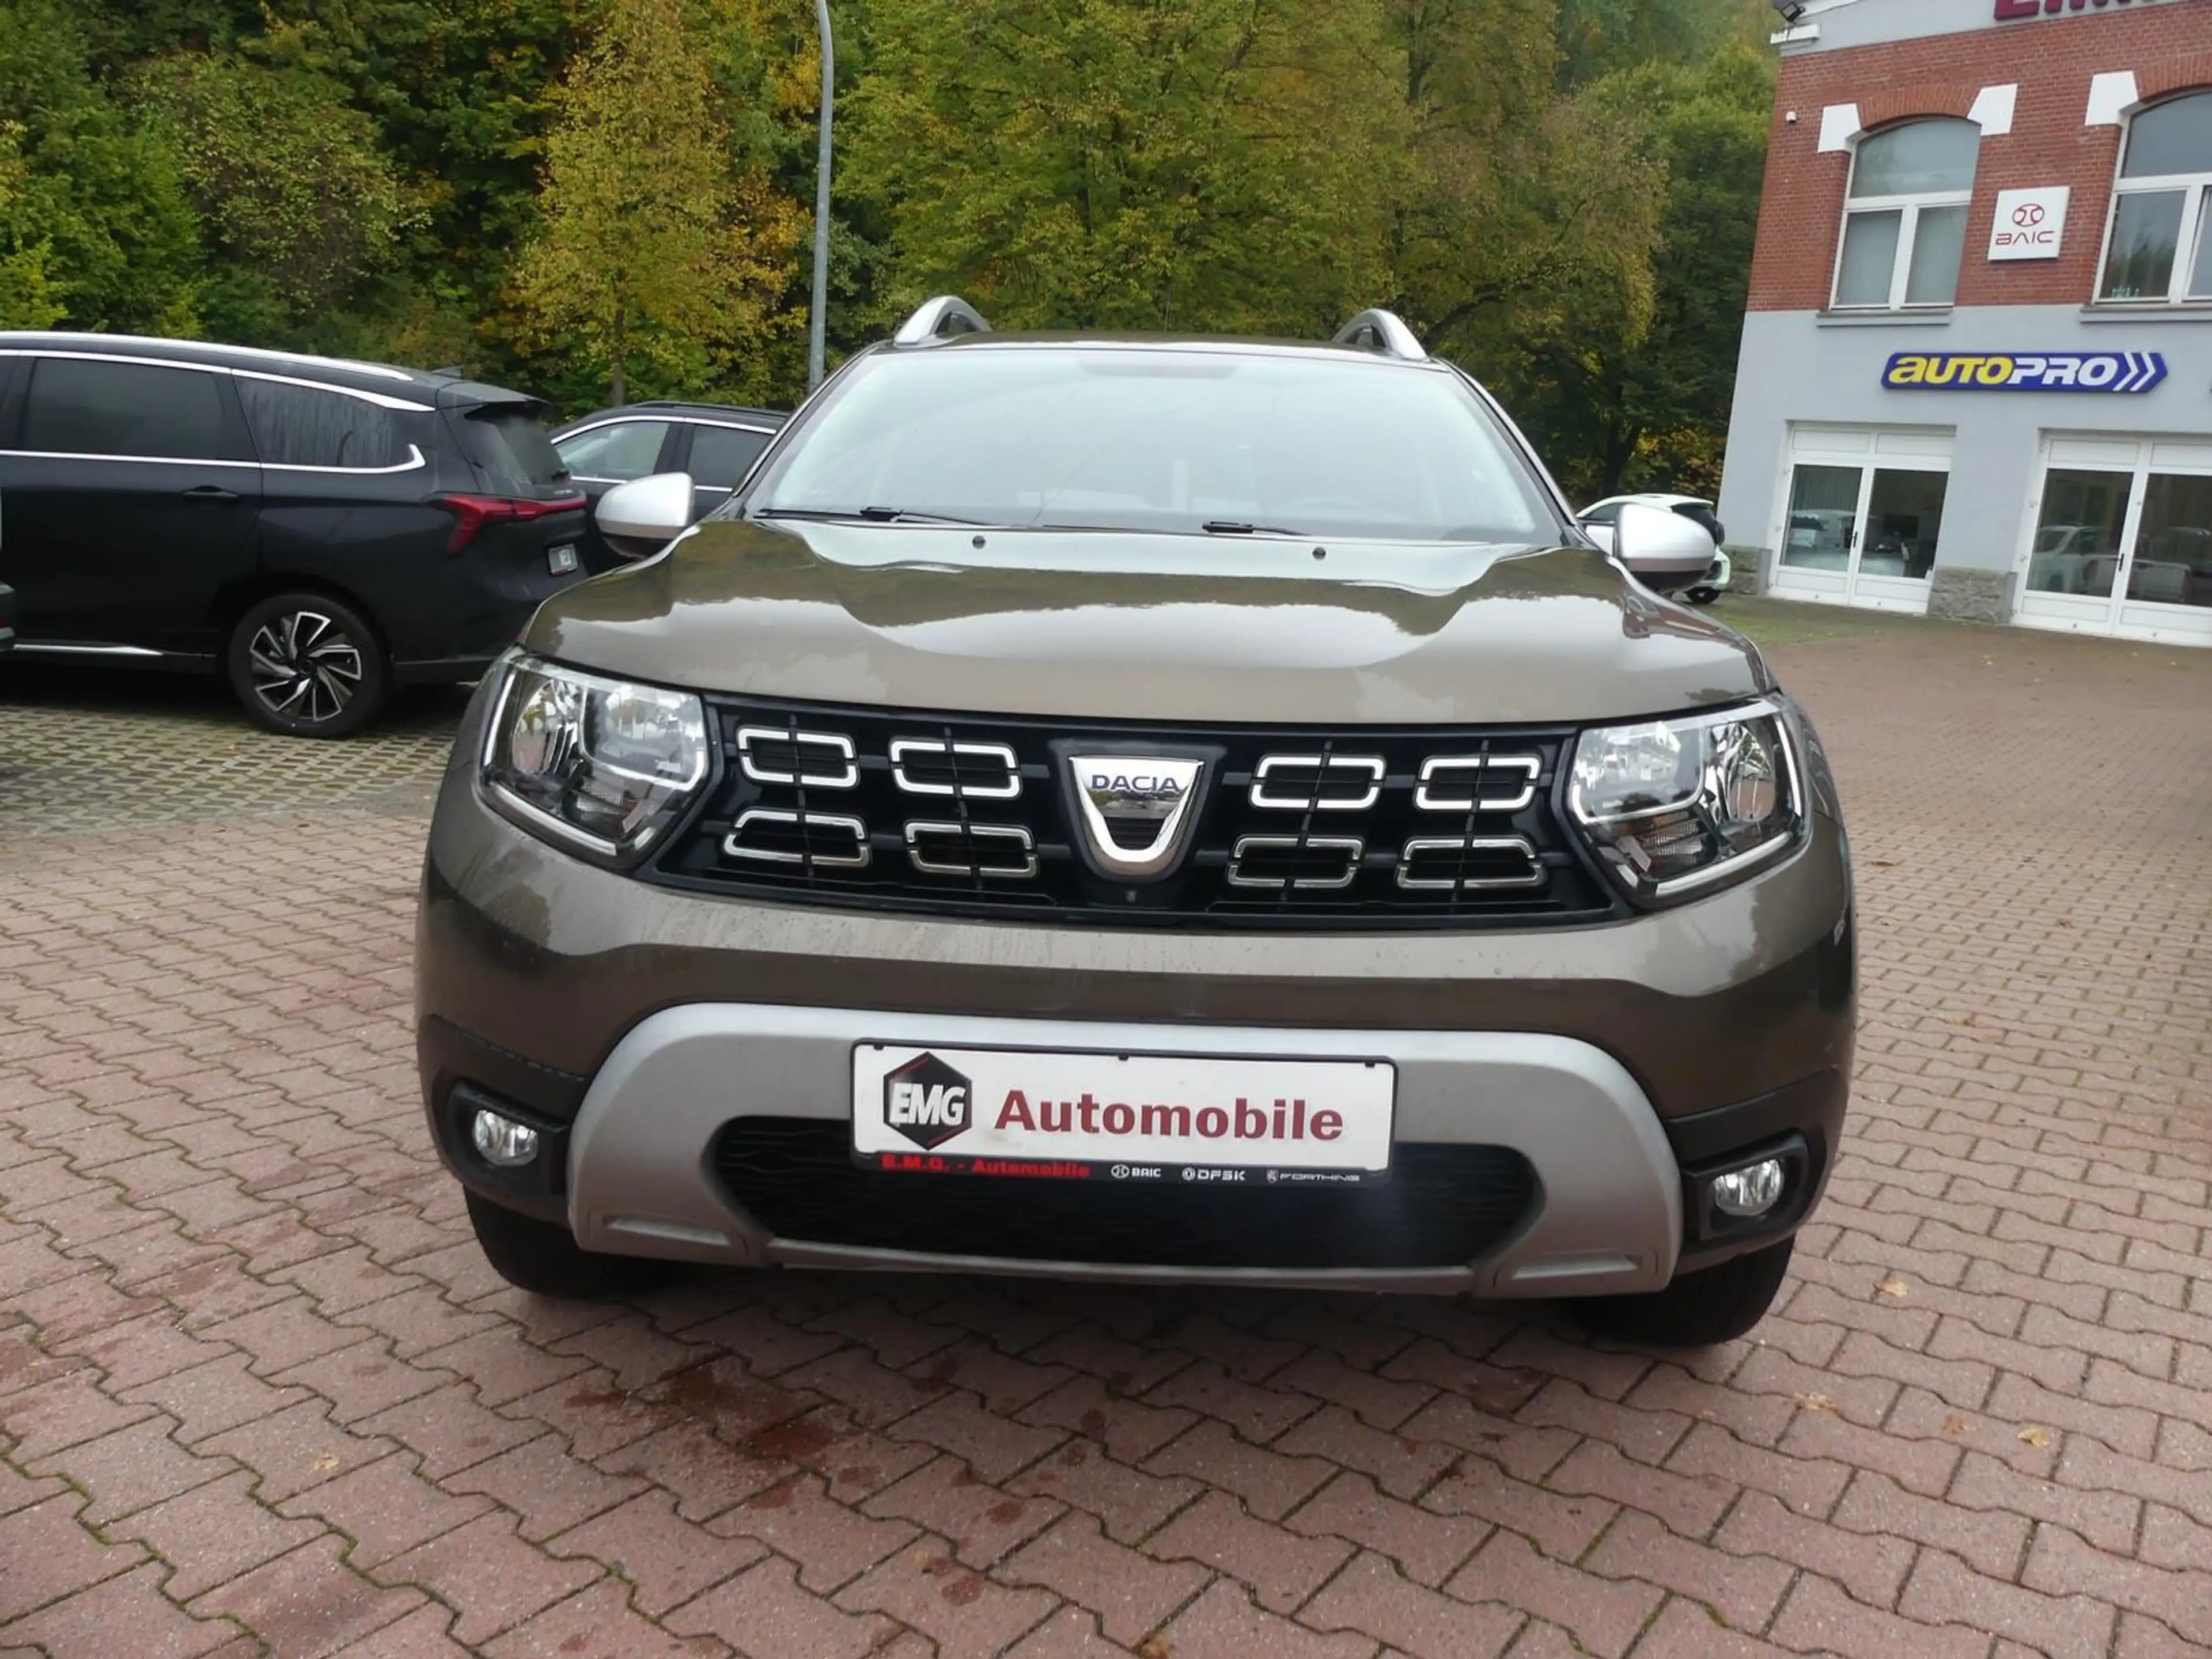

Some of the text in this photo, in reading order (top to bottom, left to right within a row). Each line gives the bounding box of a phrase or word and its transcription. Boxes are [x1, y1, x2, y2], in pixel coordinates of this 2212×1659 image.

[1995, 230, 2055, 245] BAIC
[1092, 774, 1180, 793] DACIA
[889, 1082, 967, 1126] EMG
[994, 1089, 1343, 1141] Automobile
[972, 1158, 1092, 1177] Automobile
[1197, 1169, 1245, 1181] DFSK
